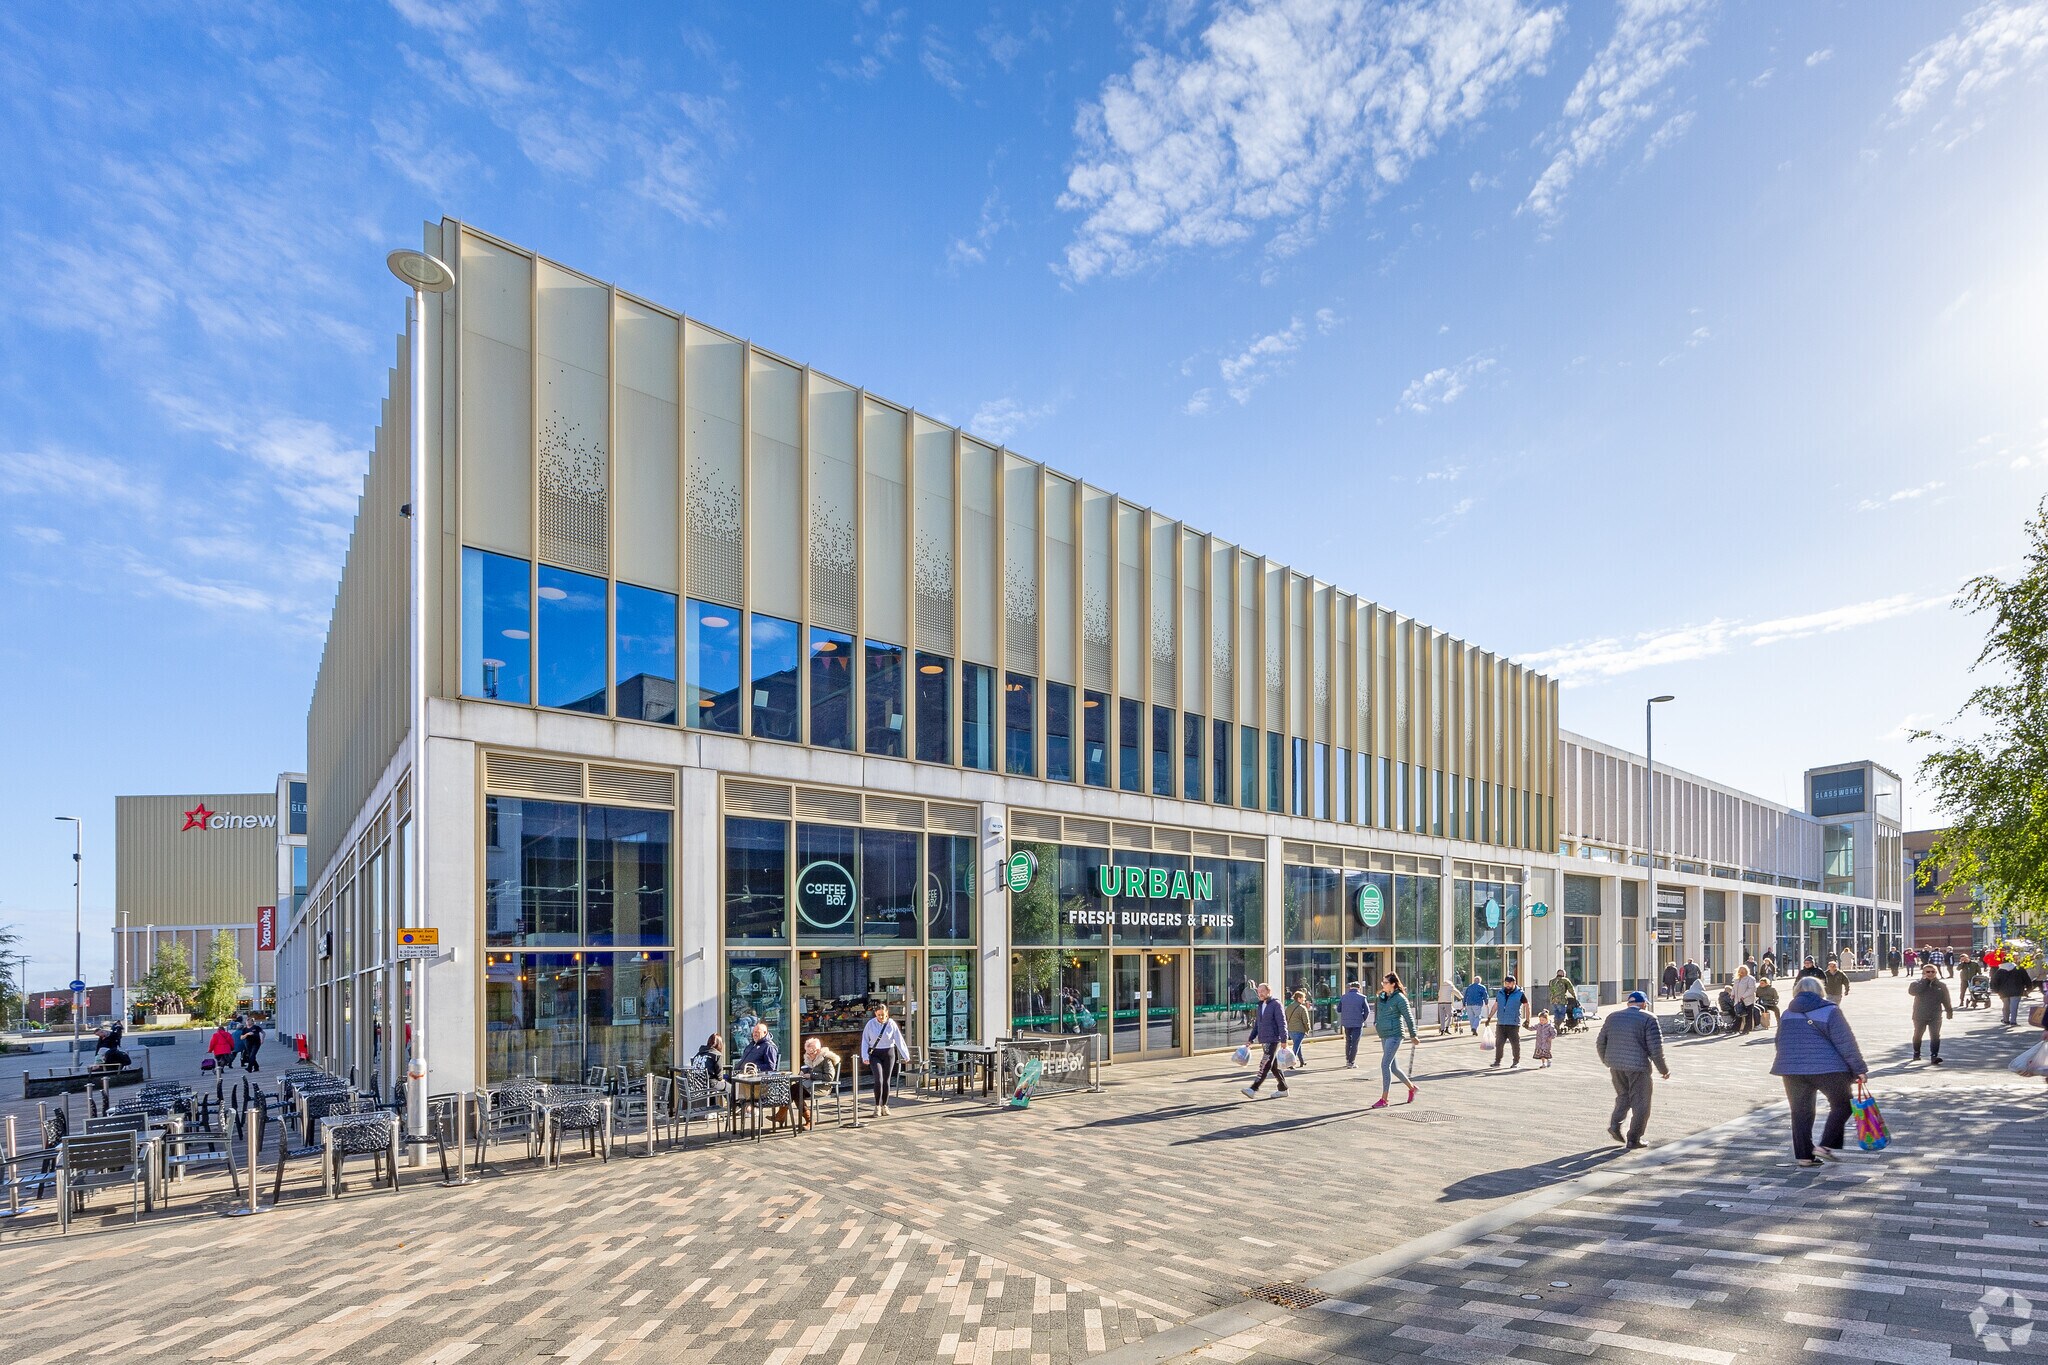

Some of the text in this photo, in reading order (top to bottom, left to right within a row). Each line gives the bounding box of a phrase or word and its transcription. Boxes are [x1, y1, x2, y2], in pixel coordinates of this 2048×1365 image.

[1815, 786, 1863, 799] GLASSWORKS
[805, 883, 847, 895] COFFEE
[1100, 865, 1212, 900] URBAN
[1069, 911, 1234, 926] FRESH BURGERS & FRIES
[1014, 1055, 1085, 1078] CFEEBOY.
